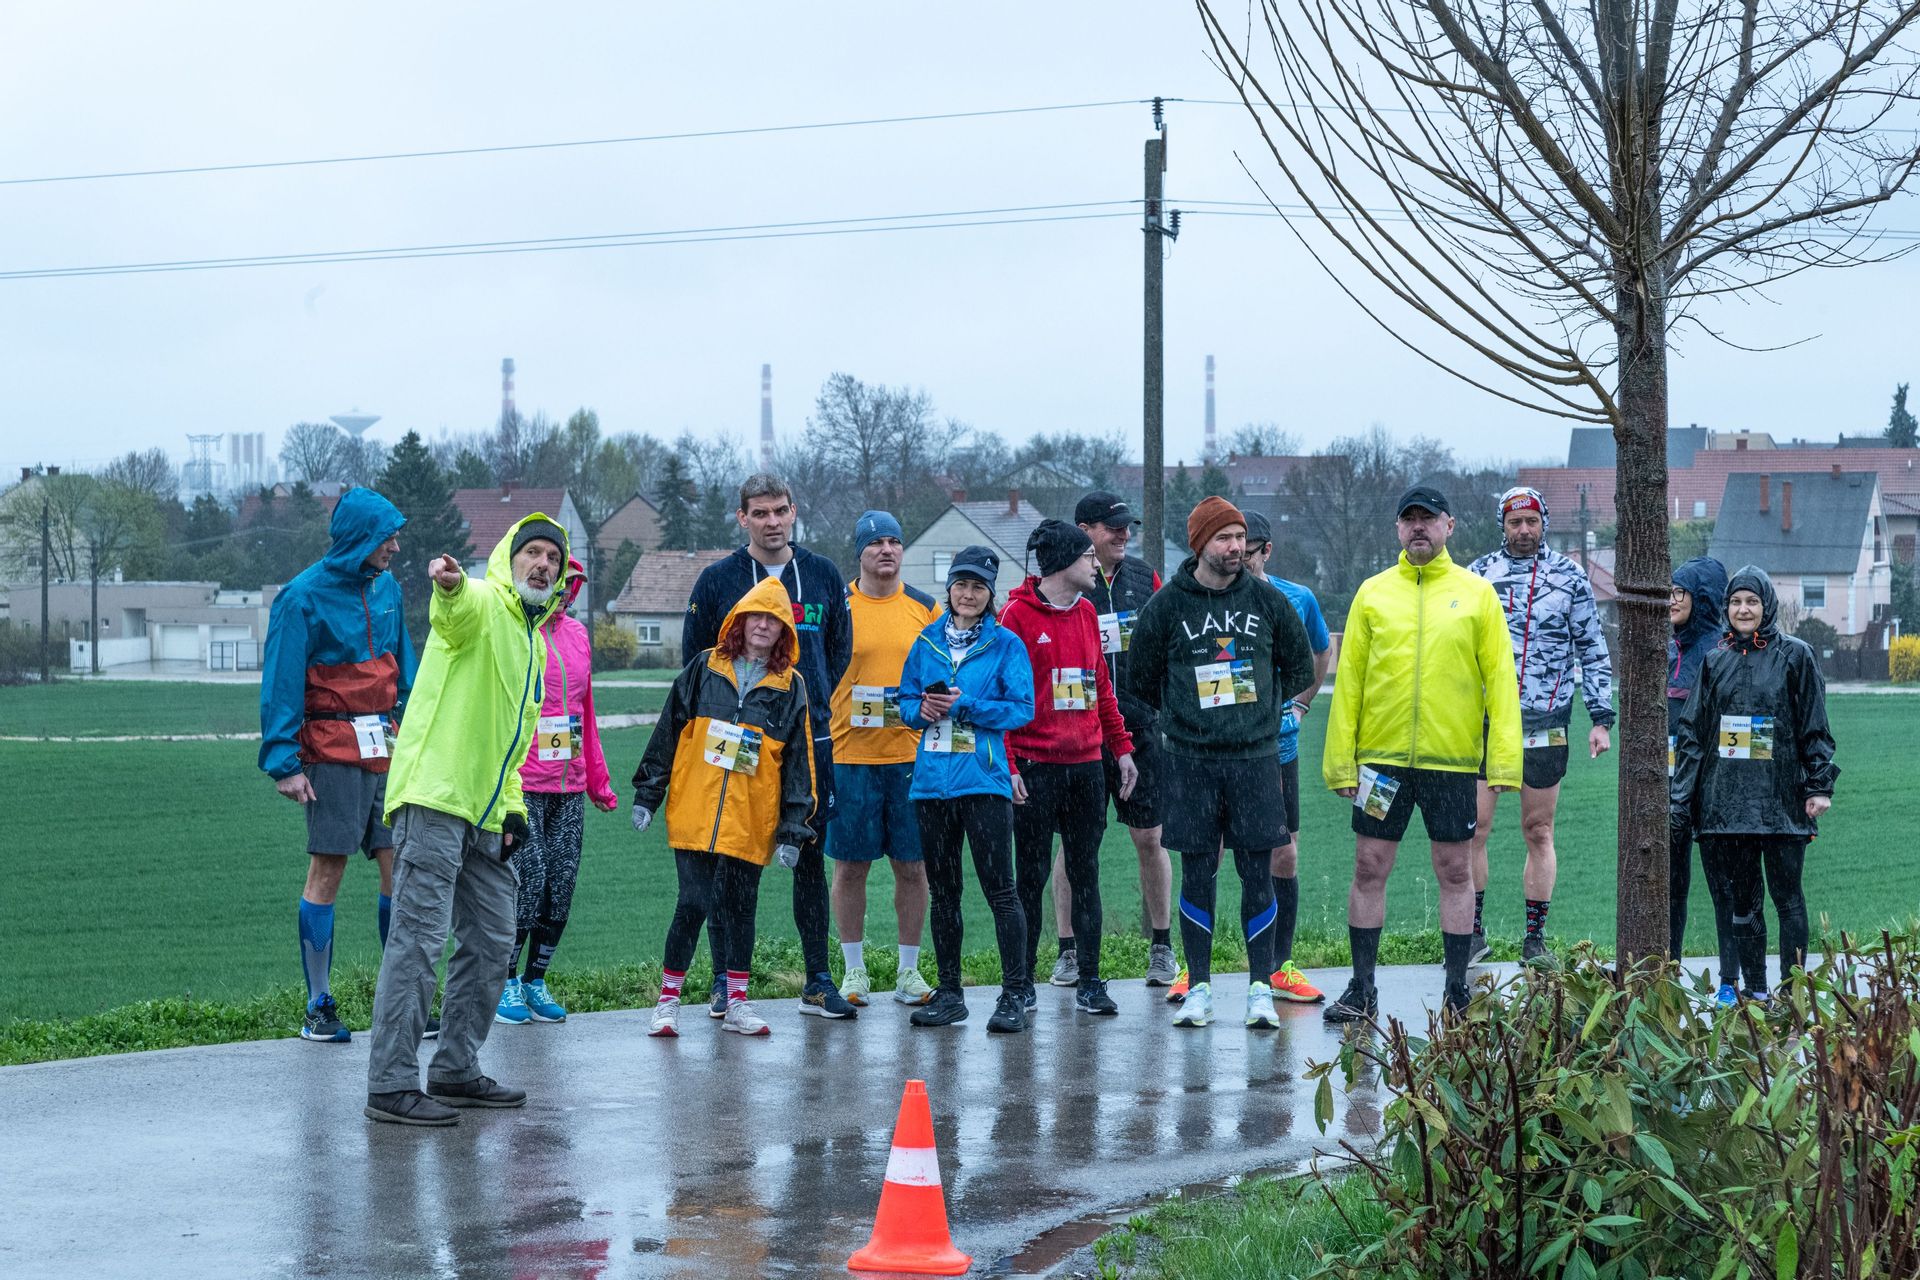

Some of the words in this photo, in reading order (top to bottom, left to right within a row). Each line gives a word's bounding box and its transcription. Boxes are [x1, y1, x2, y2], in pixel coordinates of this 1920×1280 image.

[1182, 610, 1260, 640] LAKE
[1100, 630, 1110, 643] 3
[1067, 684, 1073, 698] 1
[1210, 680, 1220, 695] 7
[862, 702, 872, 716] 5
[369, 731, 376, 745] 1
[932, 726, 941, 740] 3
[1727, 732, 1738, 747] 3
[551, 733, 561, 748] 6
[714, 739, 727, 754] 4
